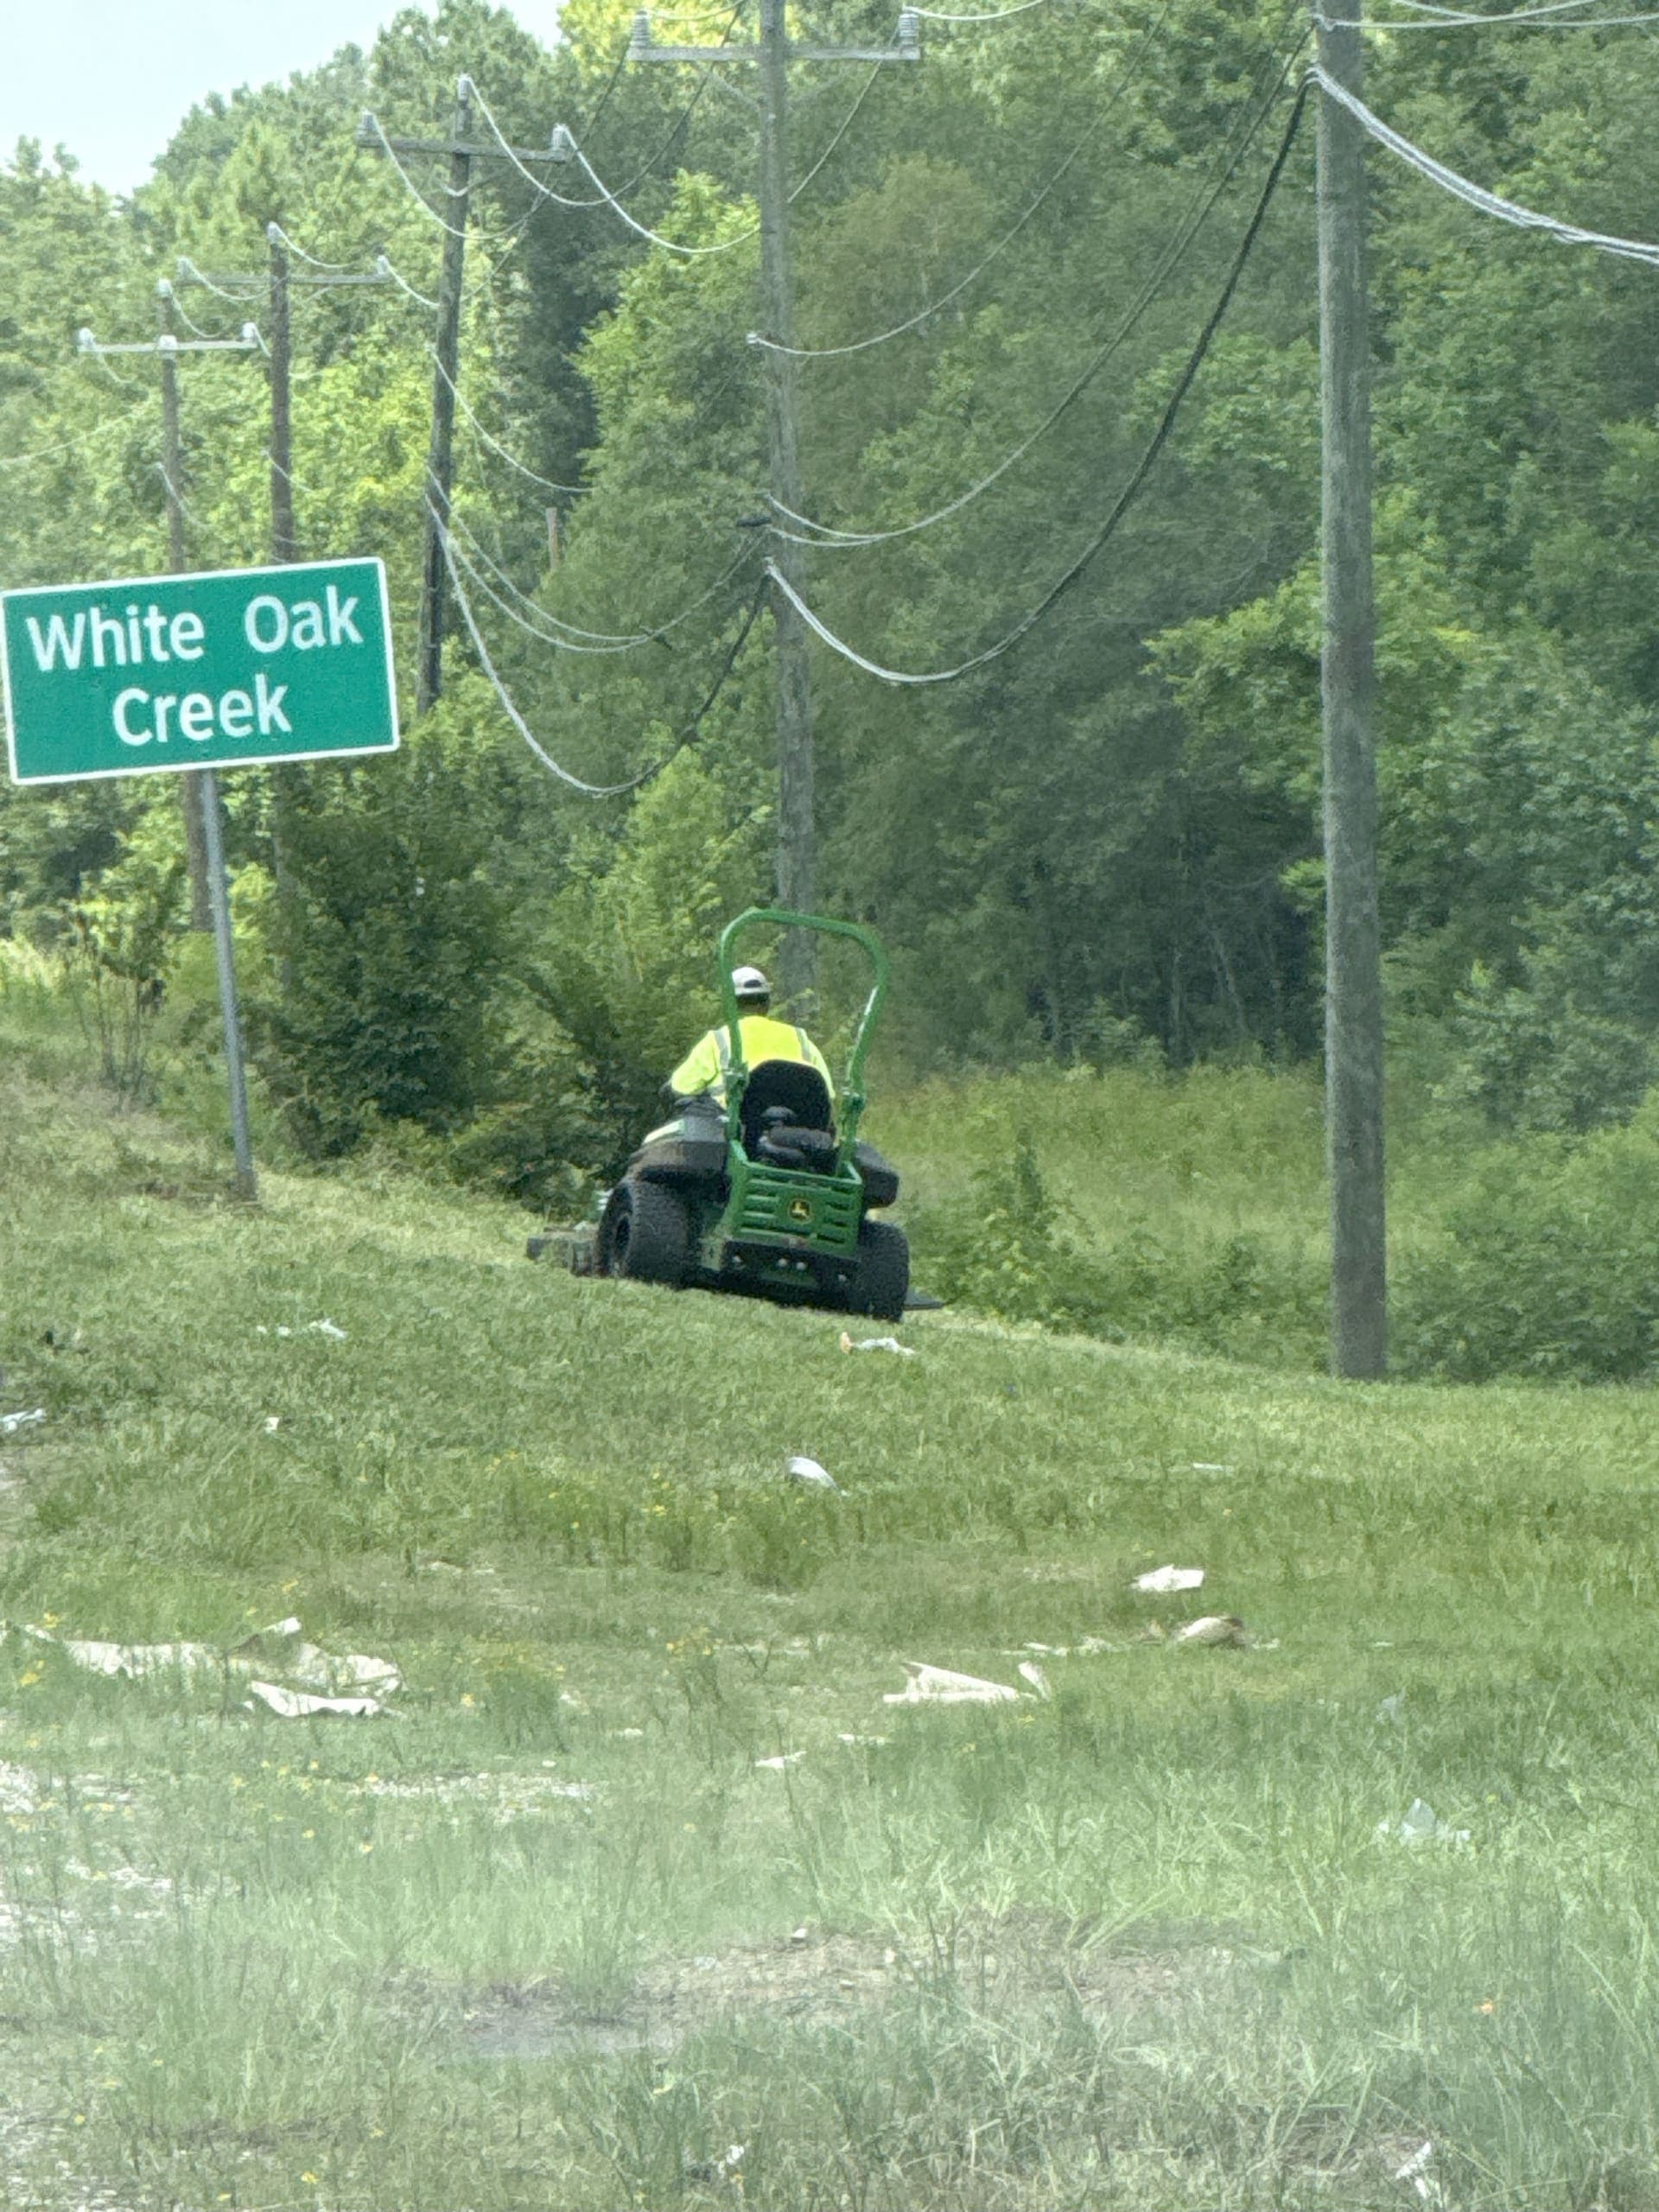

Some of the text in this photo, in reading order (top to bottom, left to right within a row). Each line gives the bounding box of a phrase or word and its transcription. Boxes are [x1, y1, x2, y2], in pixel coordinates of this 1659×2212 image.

[26, 585, 363, 672] White Oak
[112, 672, 292, 747] Creek
